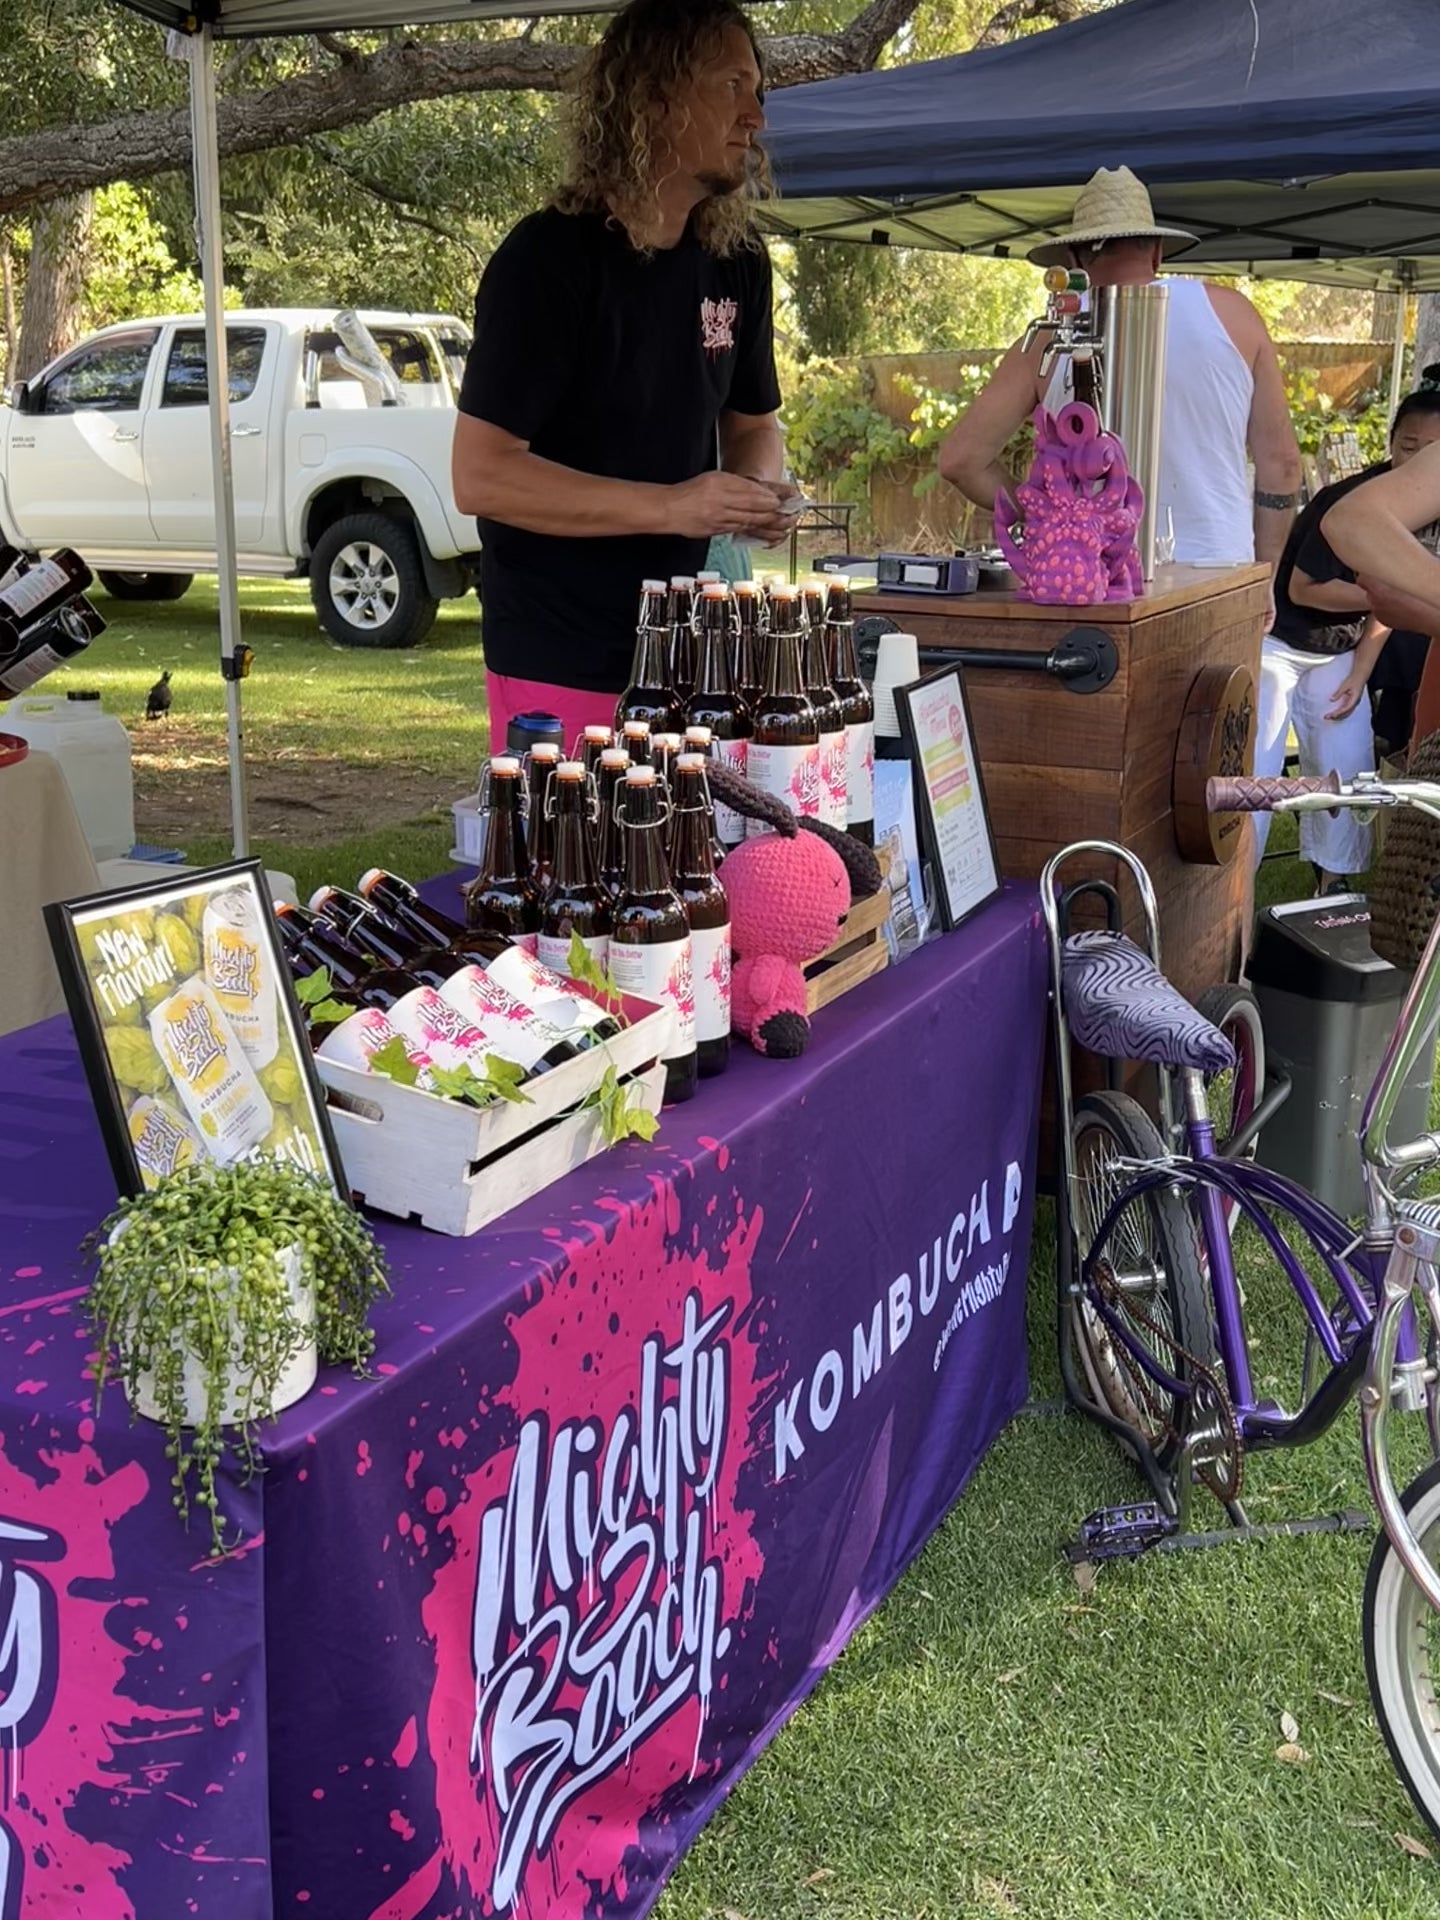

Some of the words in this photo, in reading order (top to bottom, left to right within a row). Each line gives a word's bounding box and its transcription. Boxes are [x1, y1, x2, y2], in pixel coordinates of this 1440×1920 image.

[94, 921, 148, 974] New
[95, 932, 177, 1017] Flavour!
[225, 1011, 260, 1023] BUCHA
[475, 1295, 730, 1676] Mighty
